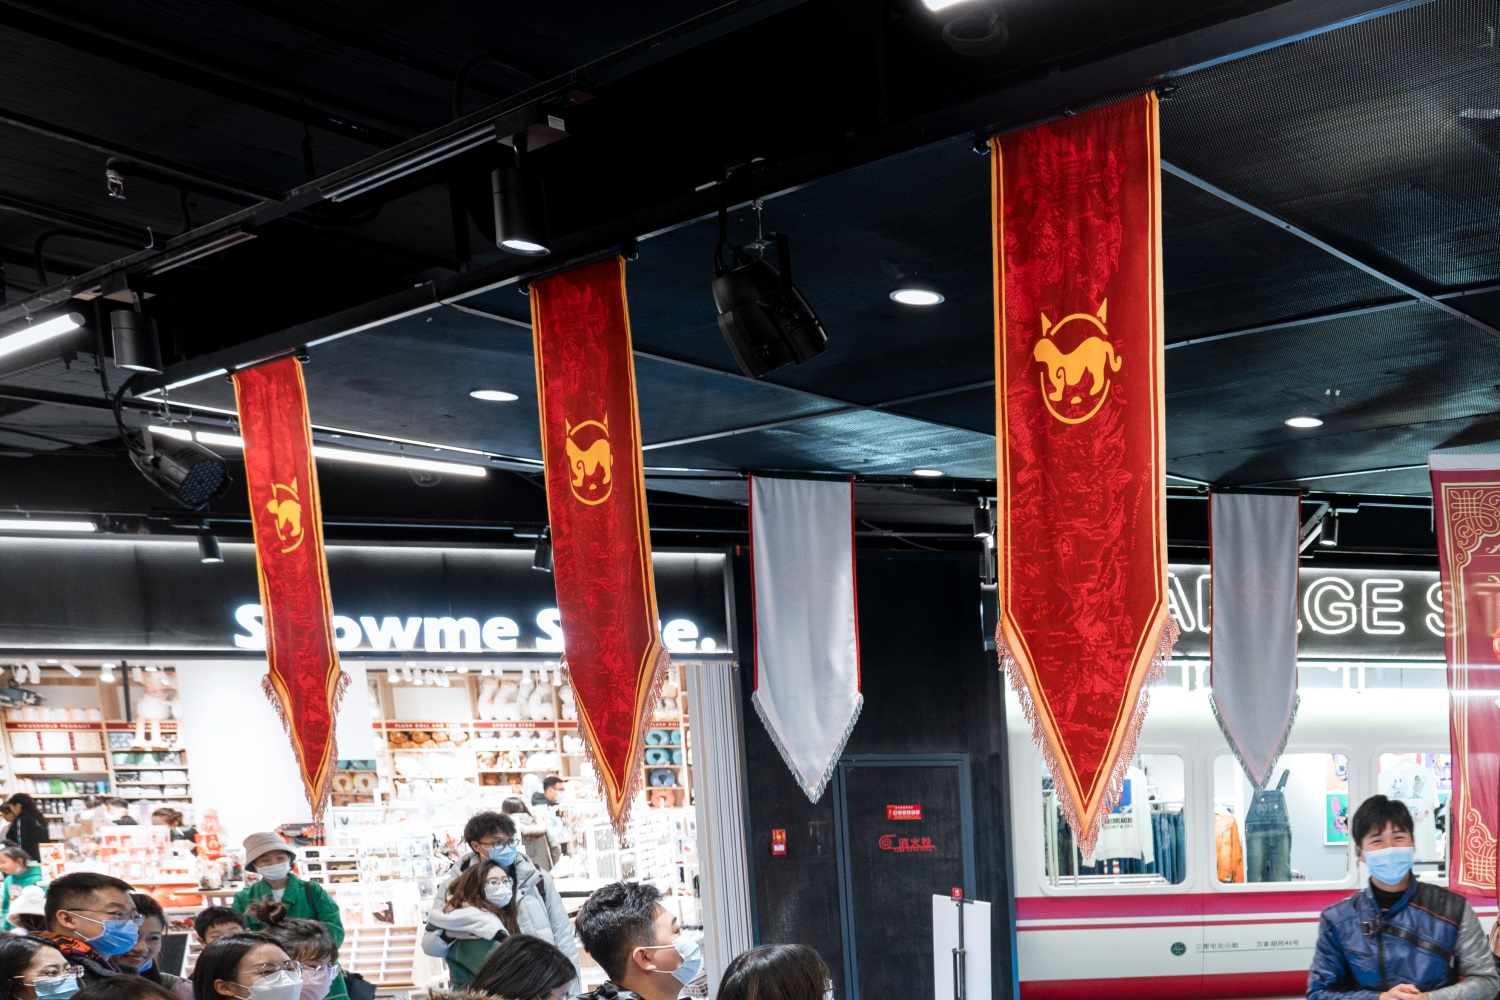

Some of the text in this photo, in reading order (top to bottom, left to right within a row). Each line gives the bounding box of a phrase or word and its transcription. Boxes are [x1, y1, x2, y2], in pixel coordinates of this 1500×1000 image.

[234, 603, 519, 652] Sowme
[898, 837, 933, 848] 消火栓
[1256, 940, 1299, 948] 方家胡同46号
